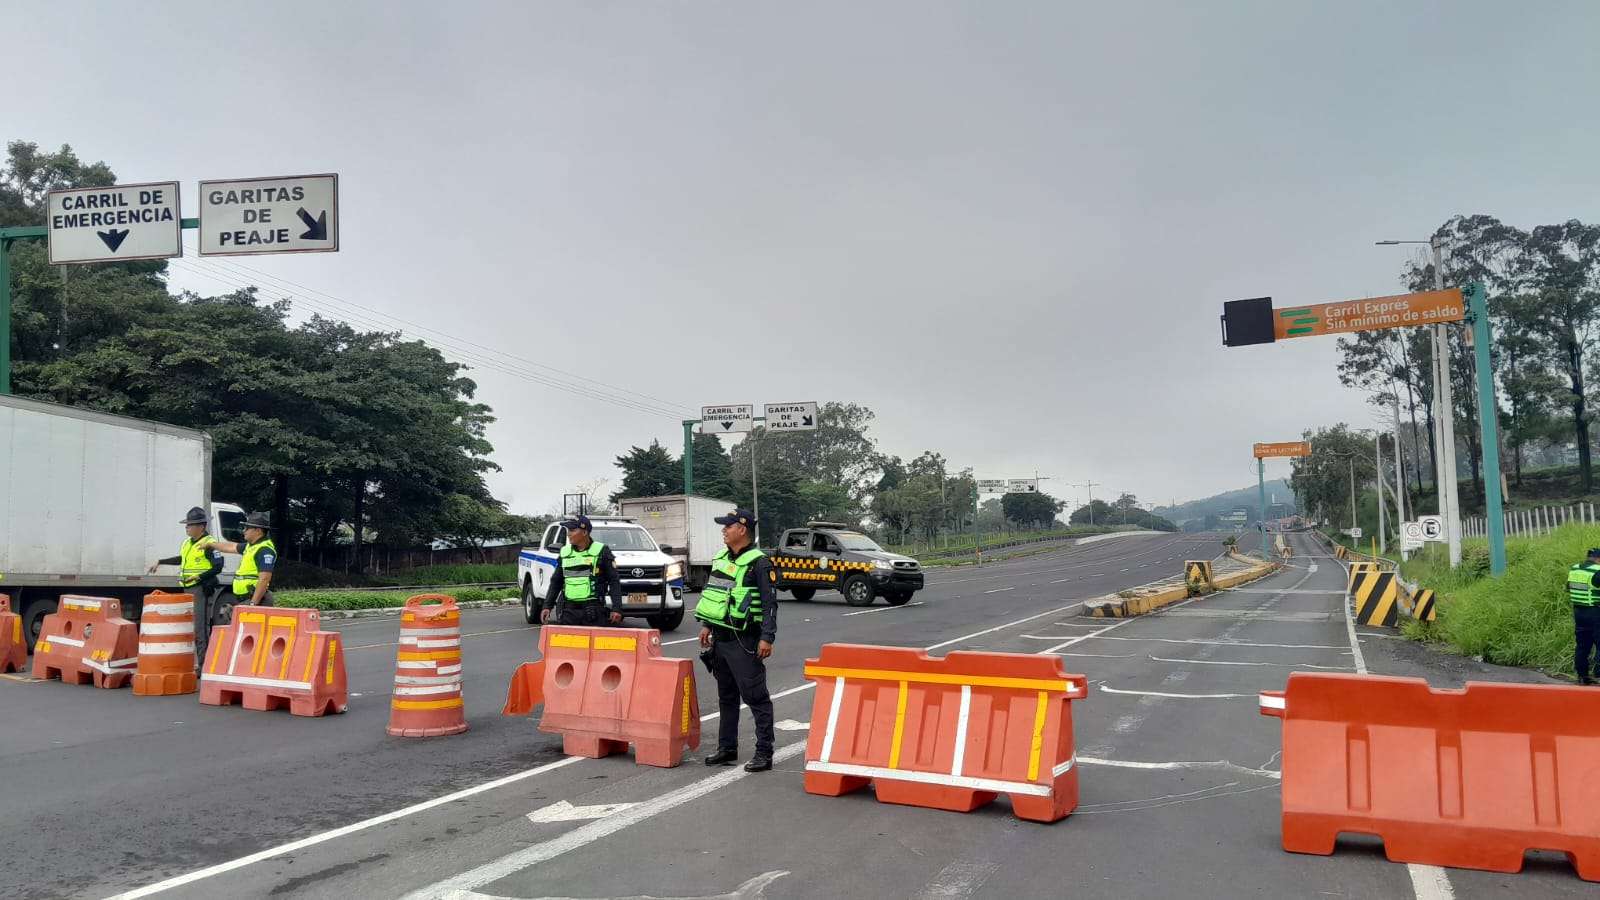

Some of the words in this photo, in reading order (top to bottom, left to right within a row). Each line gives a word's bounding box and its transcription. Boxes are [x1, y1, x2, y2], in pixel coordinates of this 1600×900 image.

[62, 192, 129, 211] CARRIL
[139, 190, 164, 205] DE
[209, 186, 305, 206] GARITAS
[53, 208, 174, 229] EMERGENCIA
[243, 209, 272, 224] DE
[219, 228, 290, 246] PEAJE
[1325, 304, 1361, 318] Carril
[1364, 300, 1409, 315] Exprés
[1326, 318, 1346, 330] Sin
[1402, 309, 1419, 321] de
[1421, 305, 1458, 320] saldo
[703, 413, 750, 422] EMERGENCIA
[768, 406, 805, 414] GARITAS
[782, 571, 836, 581] TRANSITO
